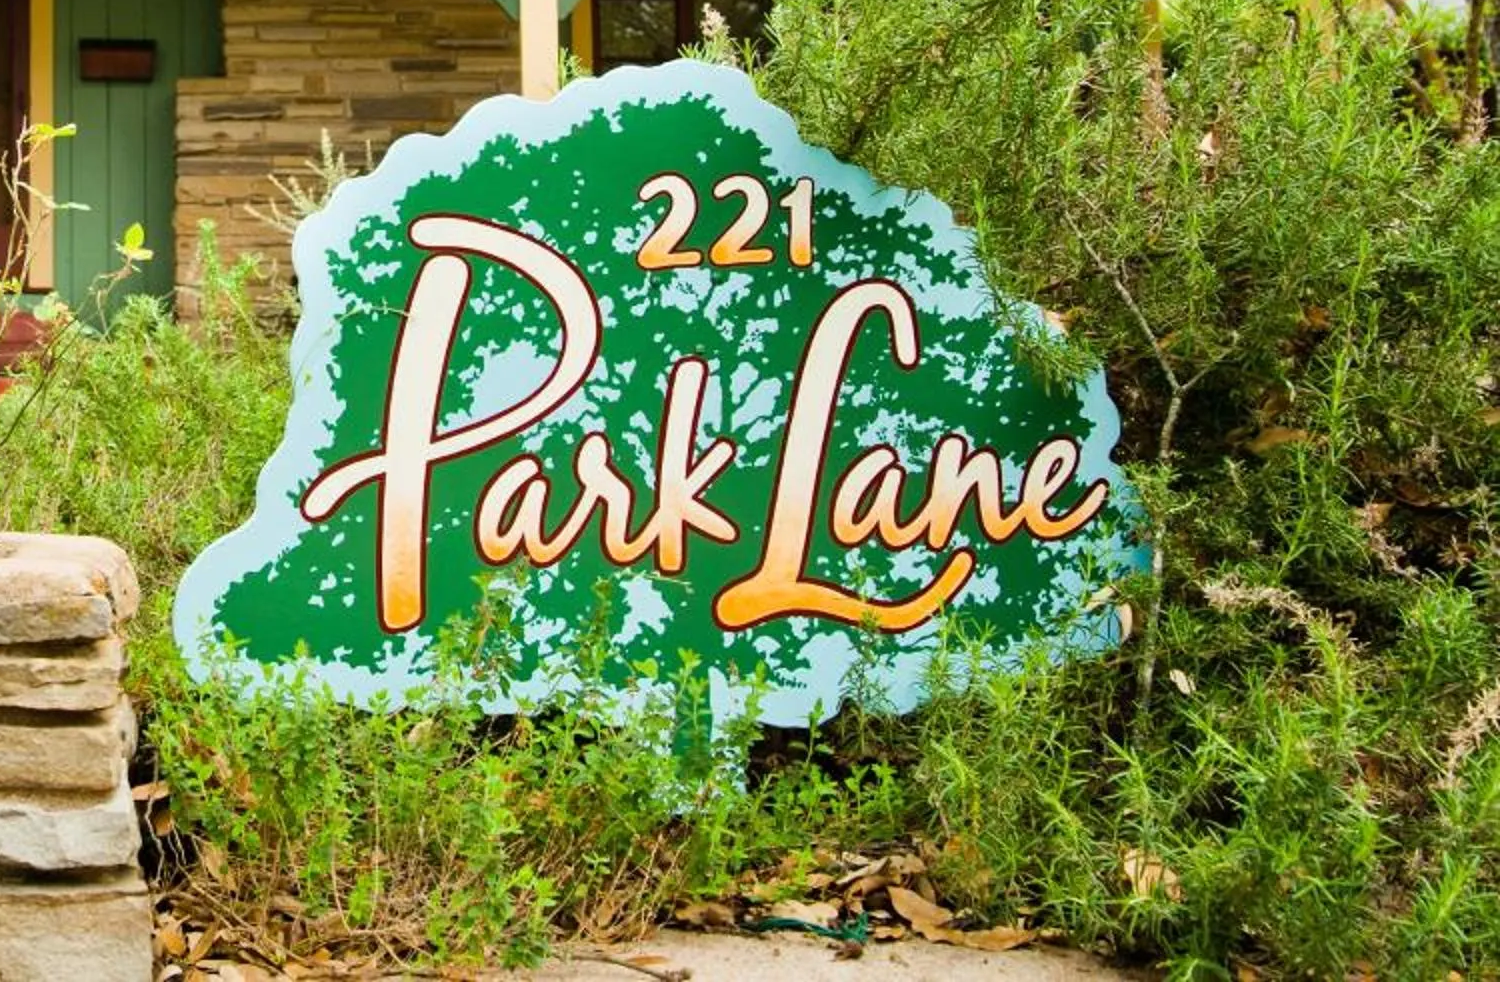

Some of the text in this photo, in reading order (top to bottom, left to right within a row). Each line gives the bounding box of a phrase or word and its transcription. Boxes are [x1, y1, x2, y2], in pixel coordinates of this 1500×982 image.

[637, 174, 815, 269] 221
[302, 214, 1110, 633] Park Lane
